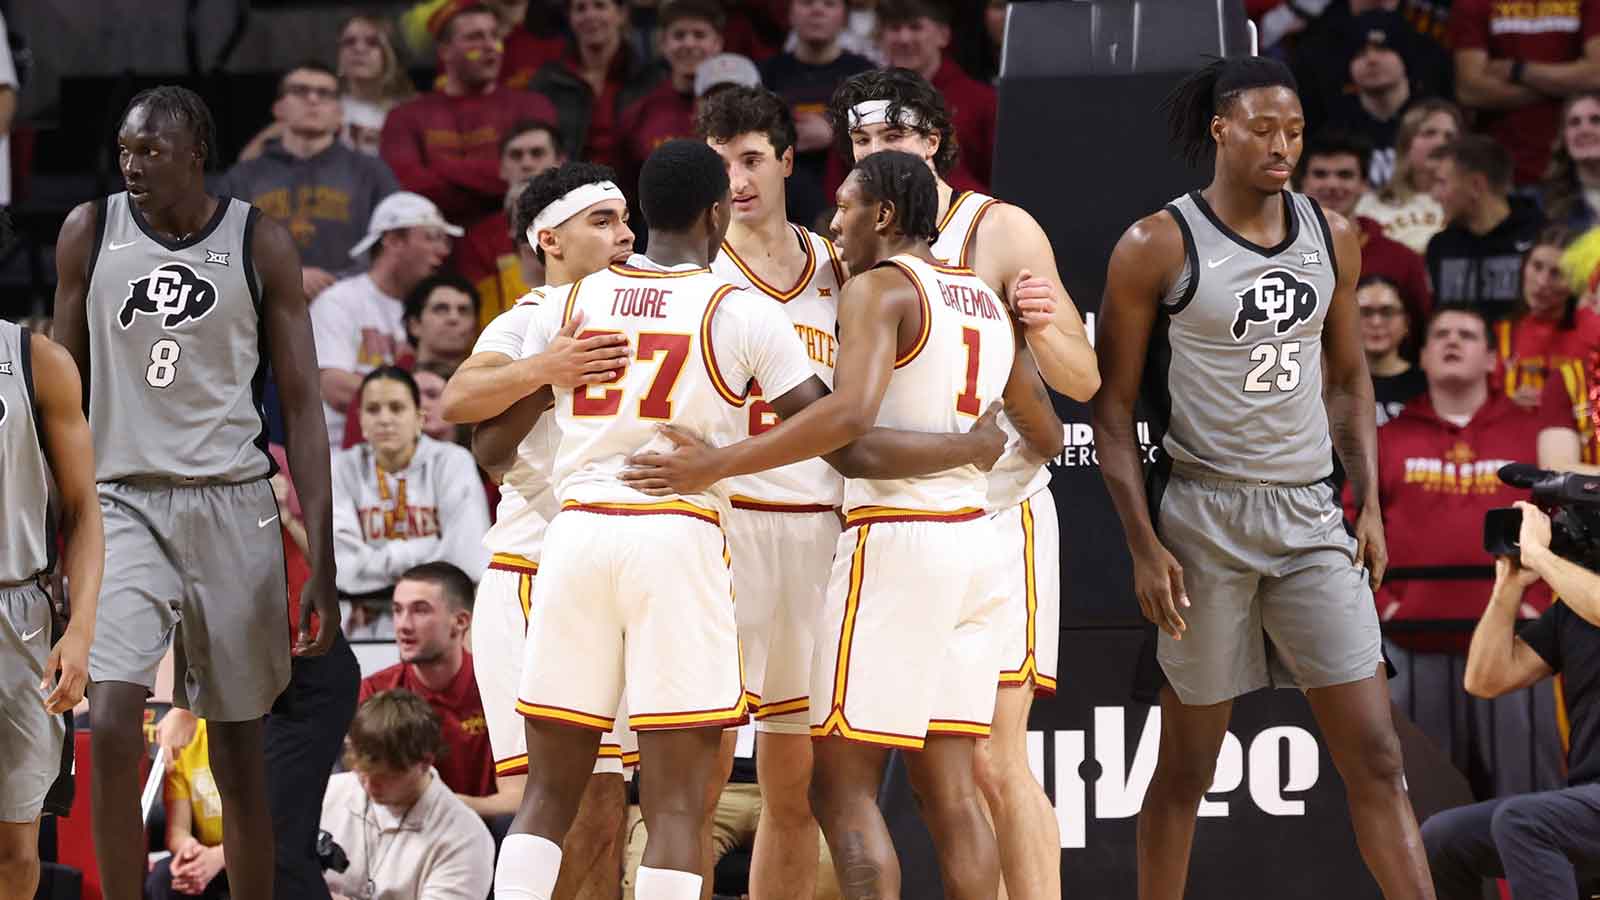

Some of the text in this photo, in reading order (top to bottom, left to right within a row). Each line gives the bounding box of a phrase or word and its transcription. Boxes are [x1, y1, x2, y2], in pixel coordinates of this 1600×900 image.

[147, 270, 193, 315] CU
[611, 287, 673, 319] TOURE
[936, 279, 1002, 321] BATEMON
[1255, 277, 1297, 320] CU
[145, 338, 181, 389] 8
[793, 322, 834, 369] TATE
[1243, 340, 1302, 393] 25
[955, 325, 982, 418] 1
